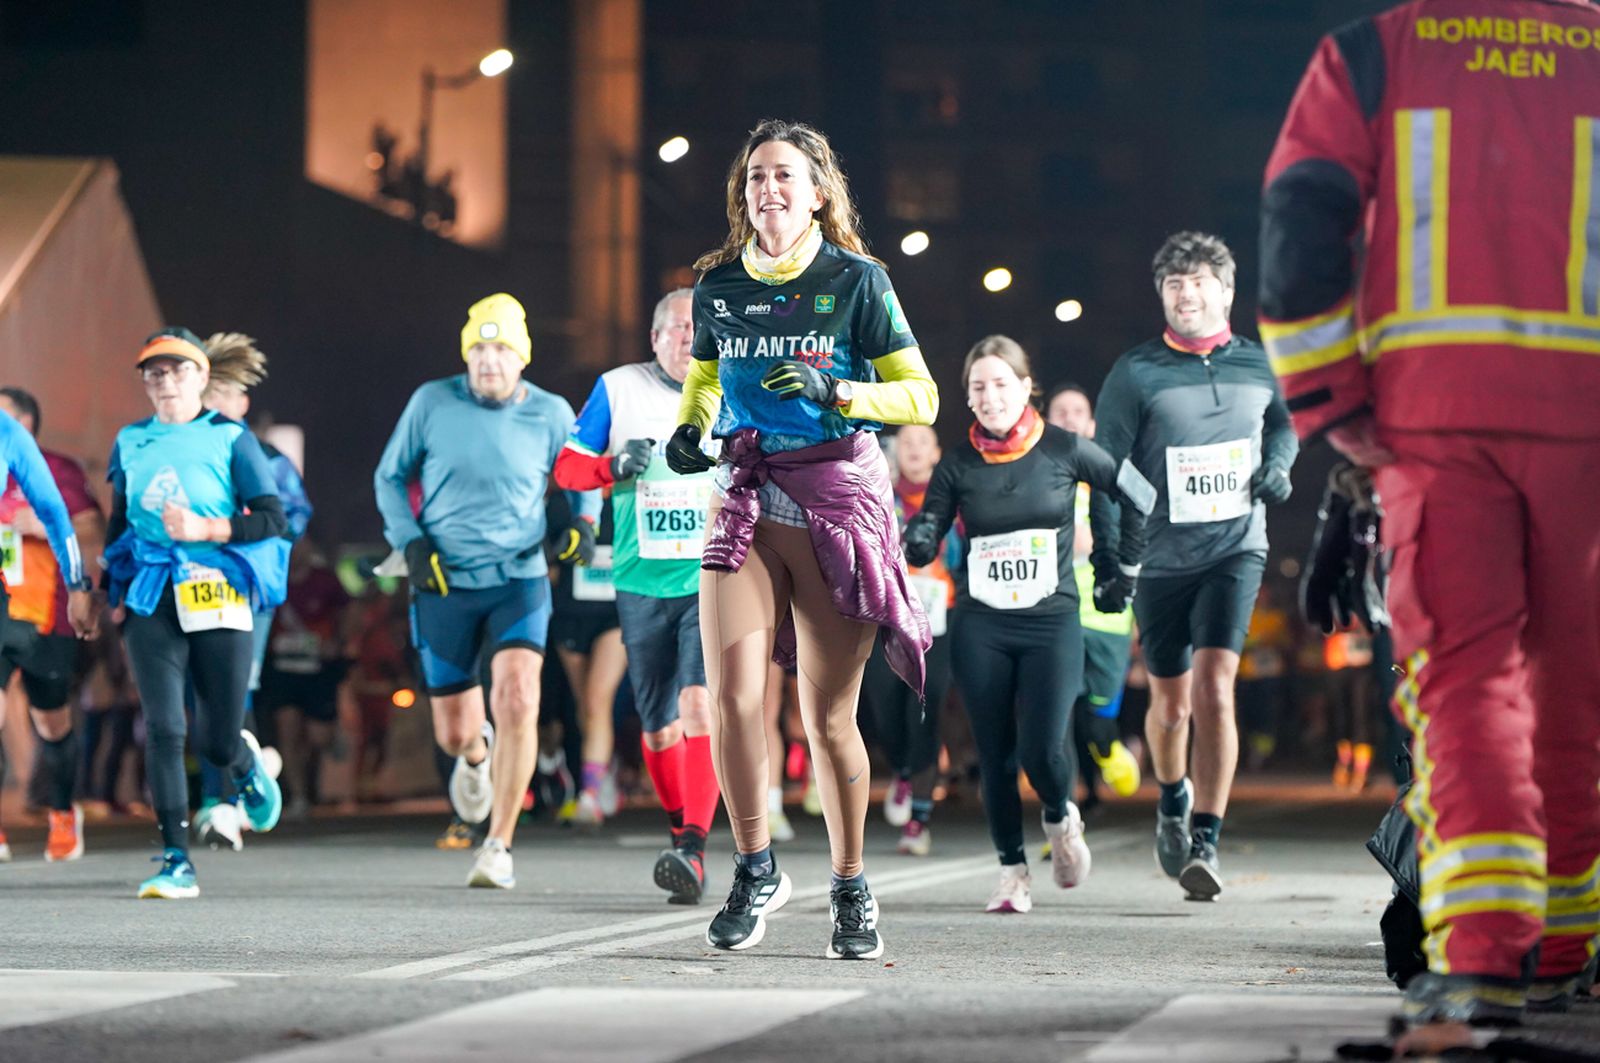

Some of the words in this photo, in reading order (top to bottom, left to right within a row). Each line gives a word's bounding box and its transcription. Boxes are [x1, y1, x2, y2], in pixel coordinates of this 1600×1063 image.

[1465, 45, 1556, 78] JAÉN
[753, 330, 835, 359] ANTÓN
[1185, 471, 1237, 496] 4606
[988, 559, 1039, 582] 4607
